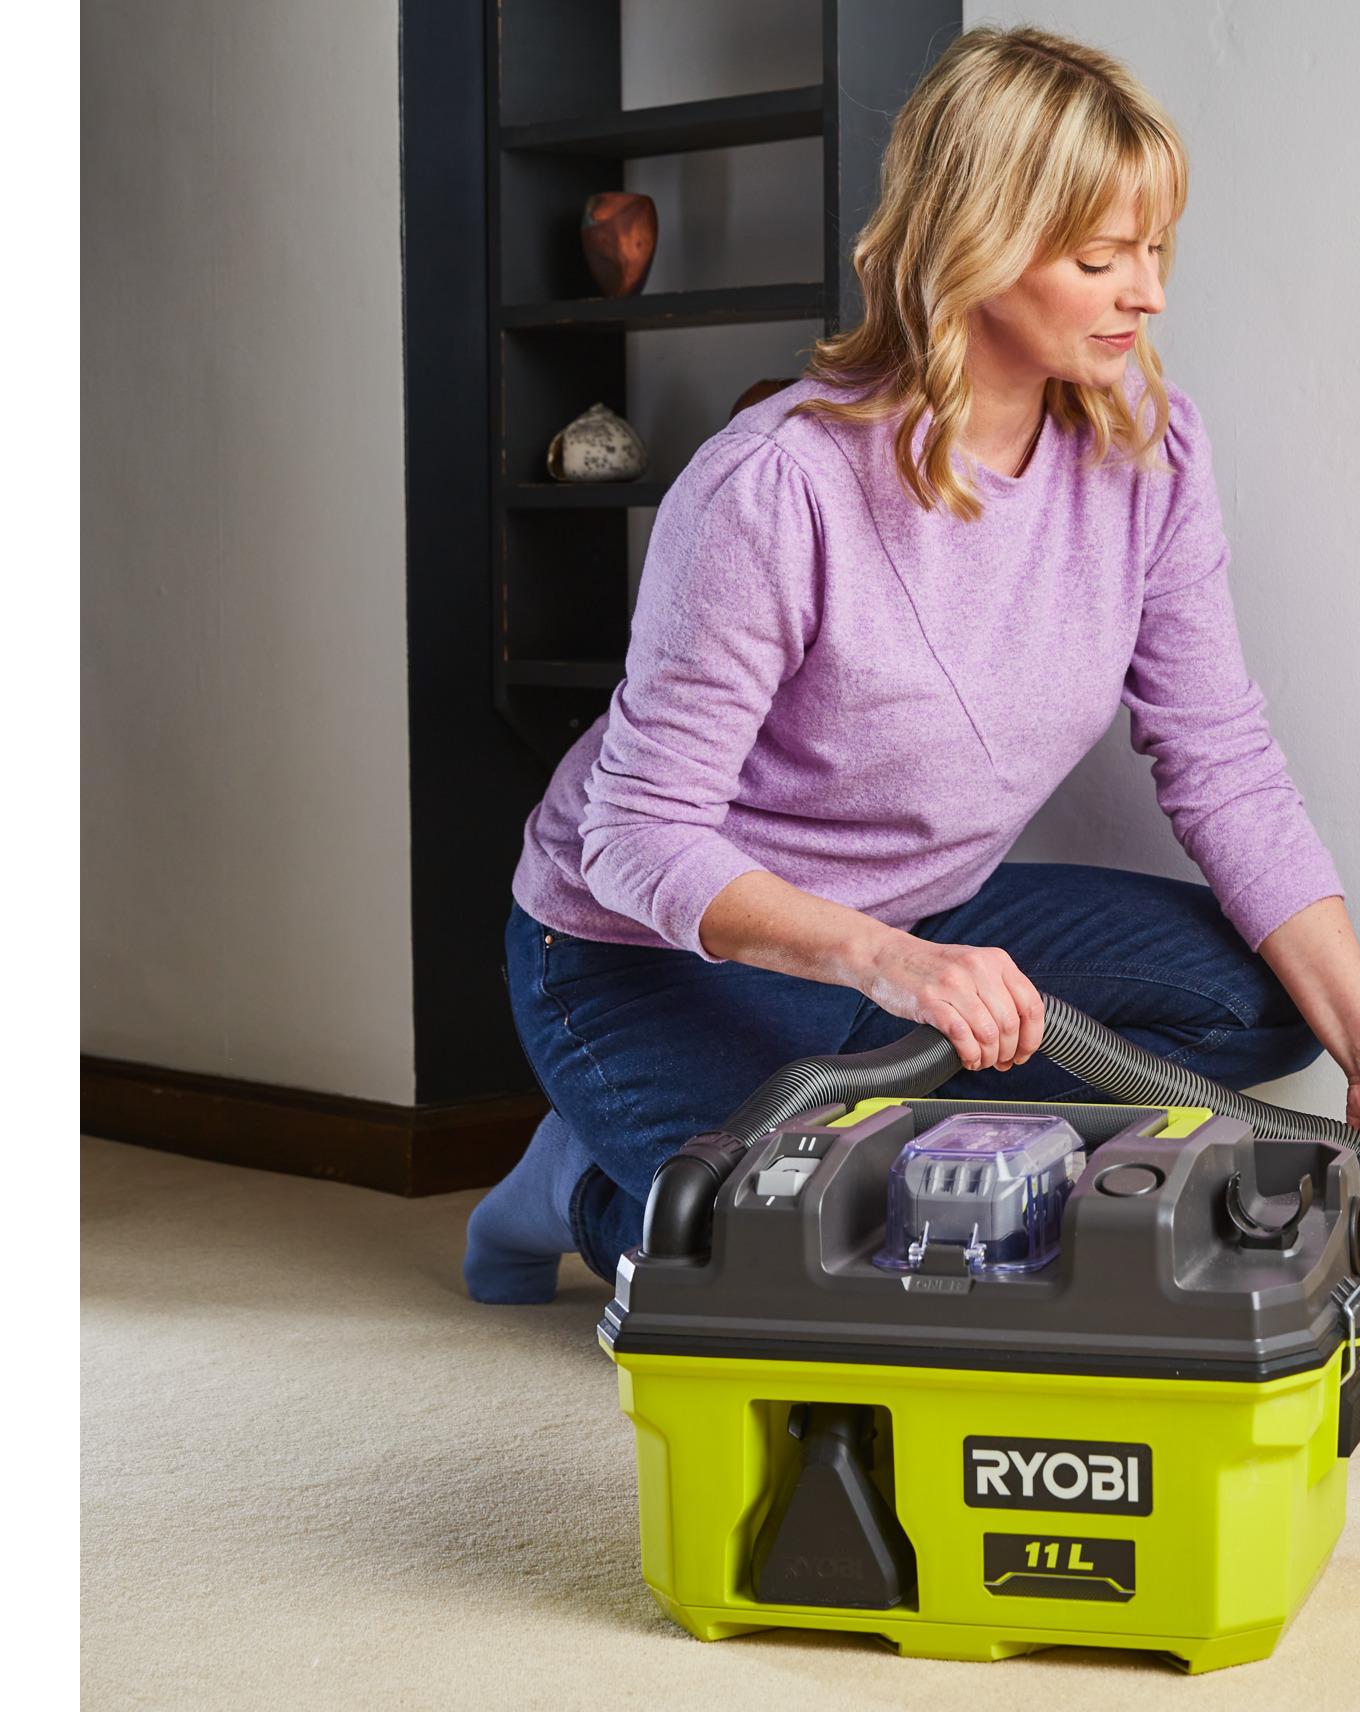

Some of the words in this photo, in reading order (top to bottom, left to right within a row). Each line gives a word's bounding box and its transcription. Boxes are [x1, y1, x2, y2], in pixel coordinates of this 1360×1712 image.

[972, 1449, 1139, 1502] RYOBI
[1025, 1541, 1060, 1568] 11
[1067, 1543, 1094, 1571] L
